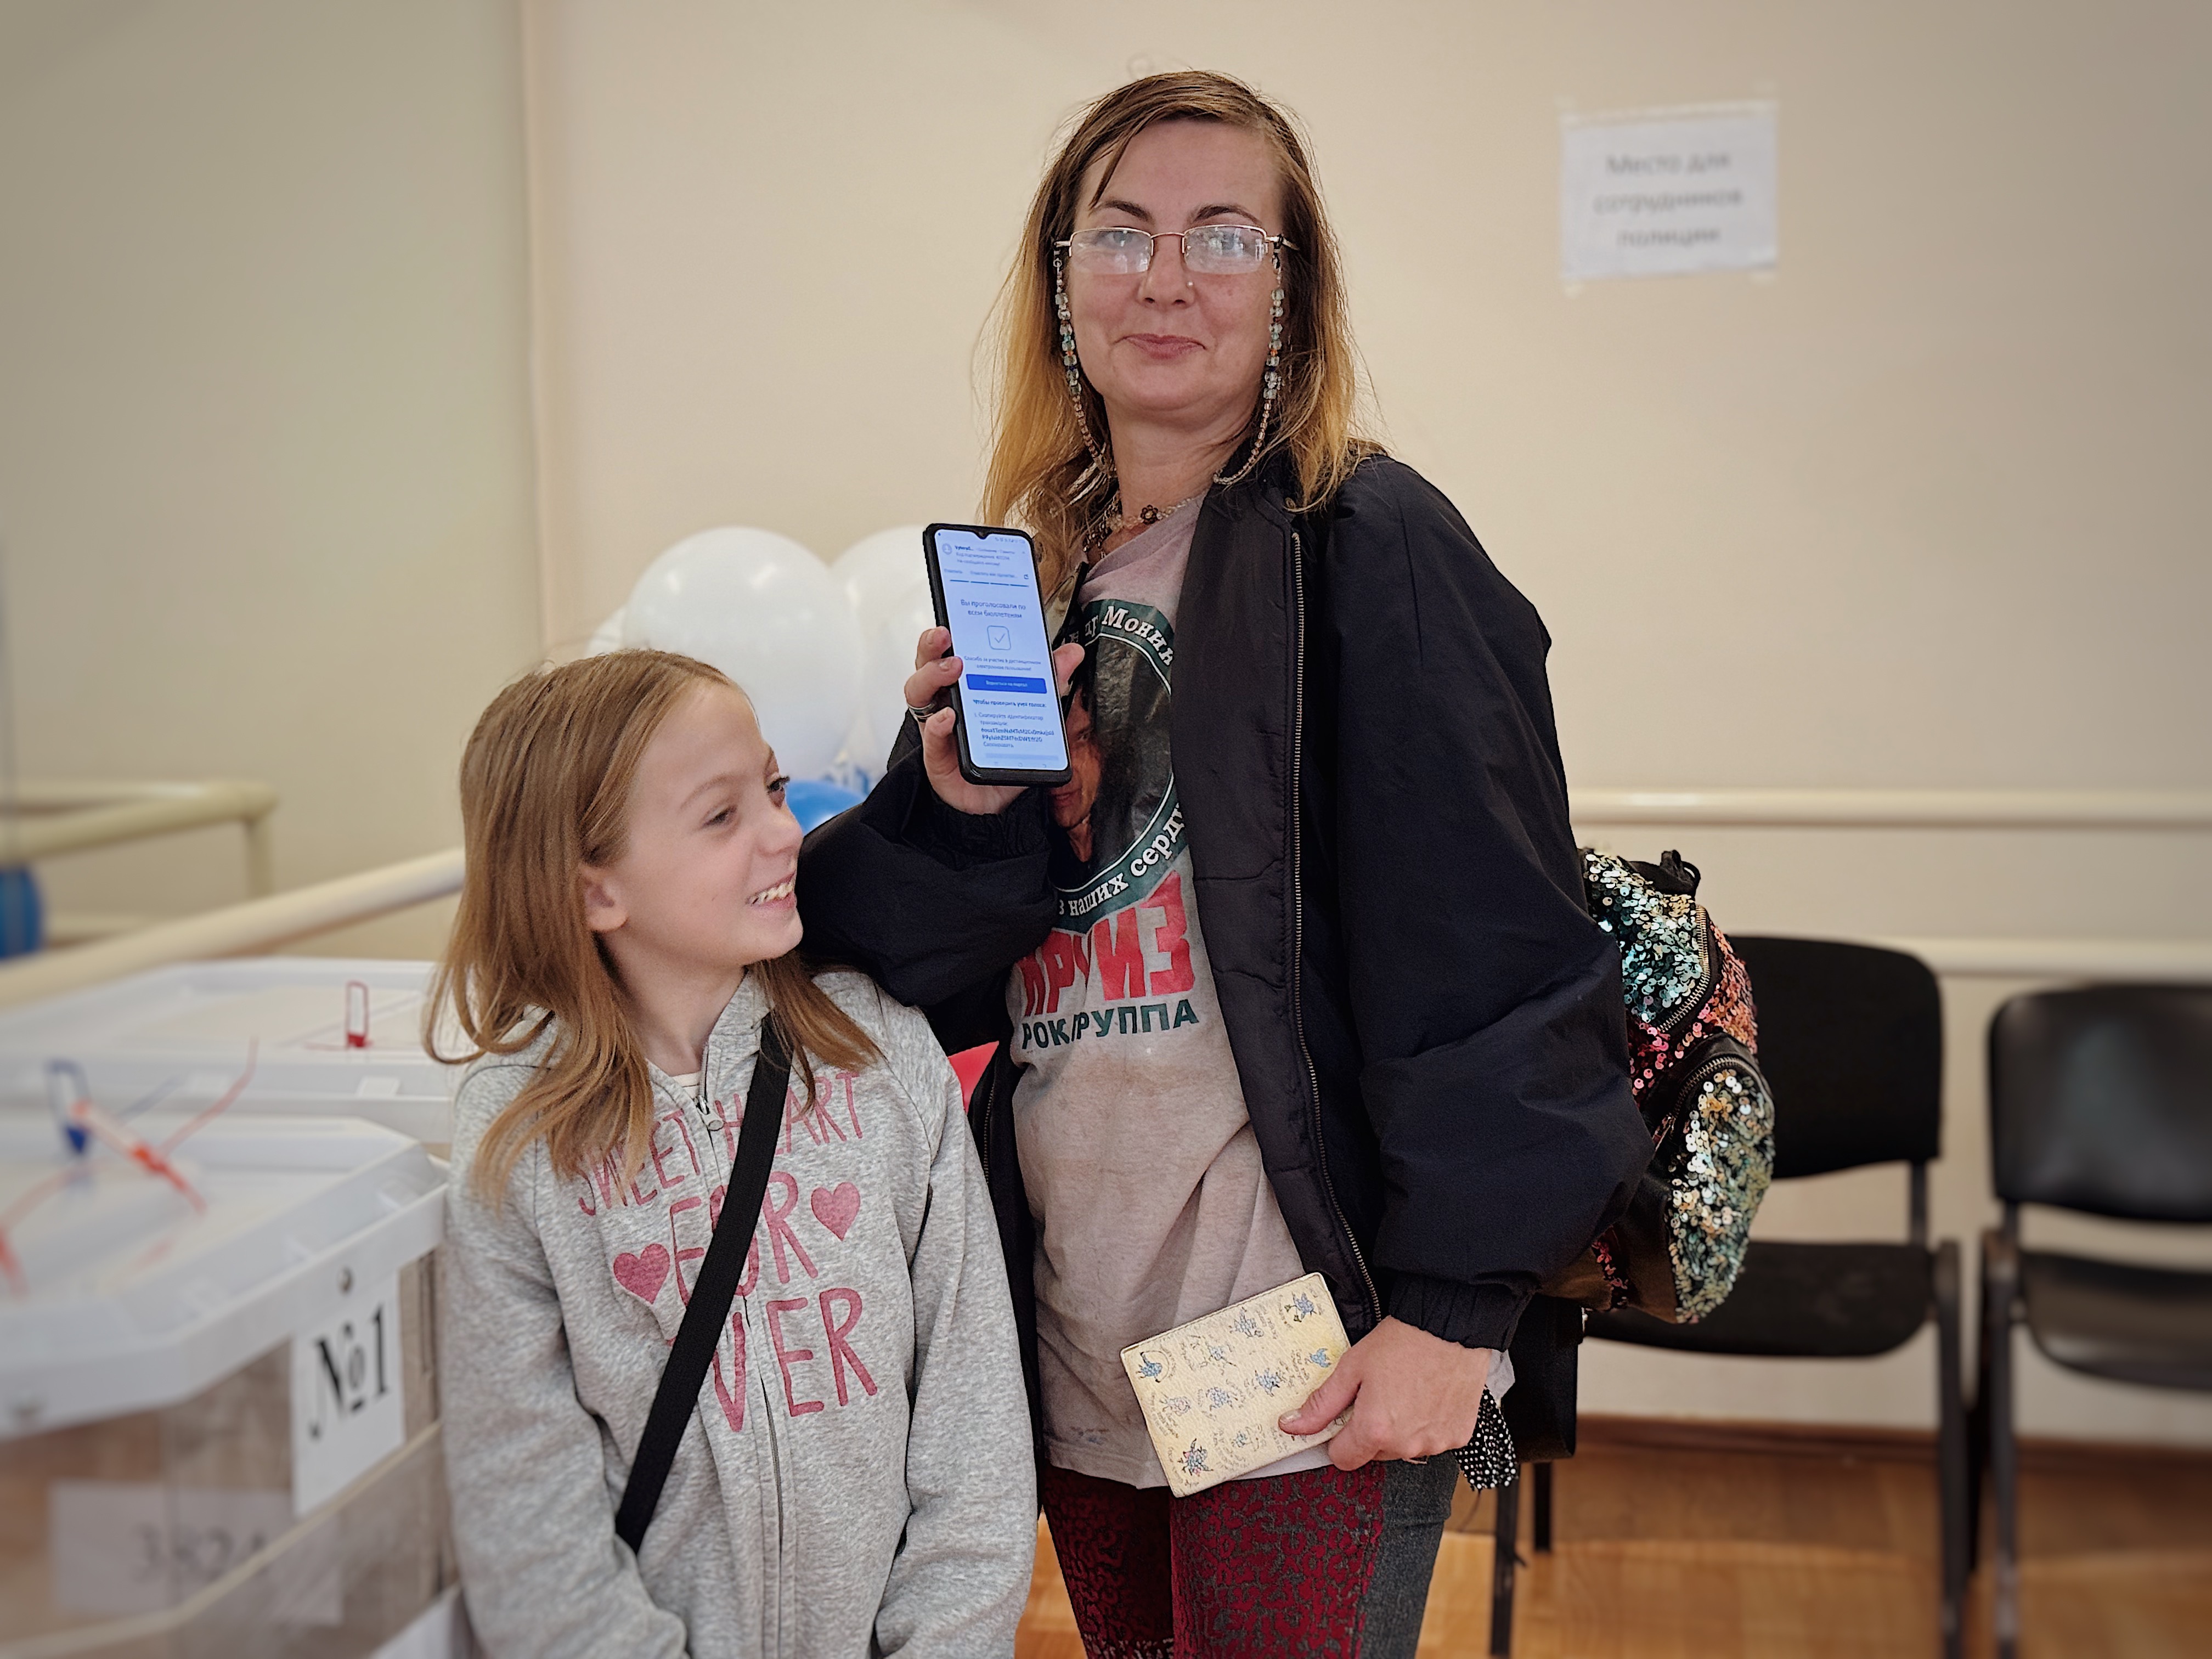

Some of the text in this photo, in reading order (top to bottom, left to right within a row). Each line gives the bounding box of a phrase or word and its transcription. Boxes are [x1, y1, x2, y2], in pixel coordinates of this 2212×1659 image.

[972, 601, 1017, 611] проголосовали
[1068, 873, 1128, 916] наших
[714, 1071, 862, 1162] HART
